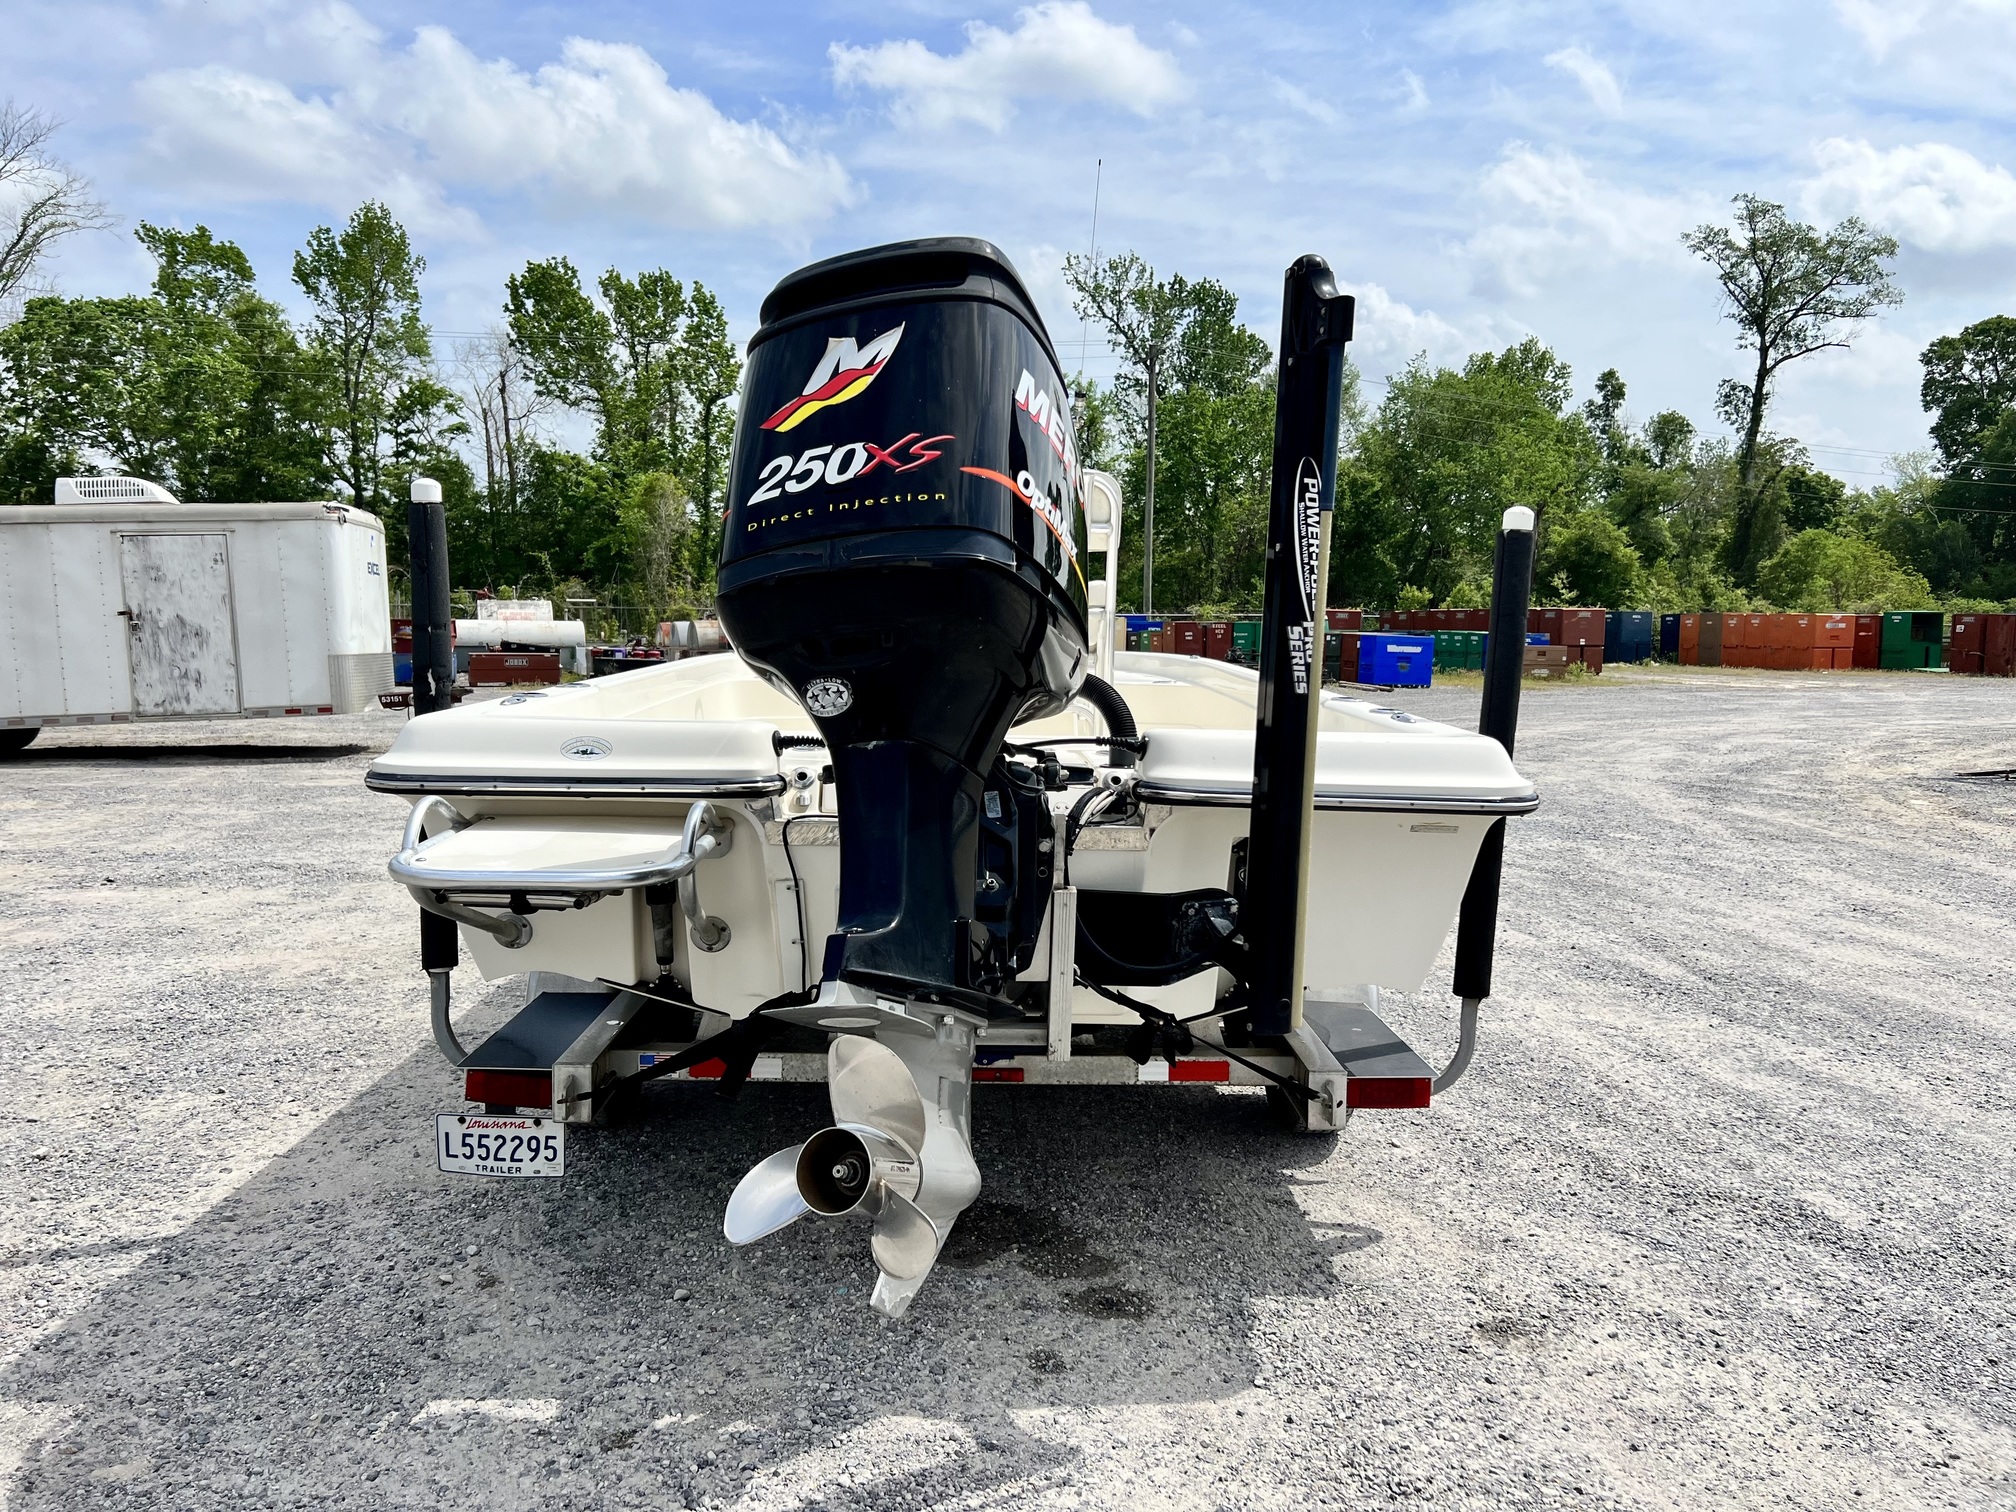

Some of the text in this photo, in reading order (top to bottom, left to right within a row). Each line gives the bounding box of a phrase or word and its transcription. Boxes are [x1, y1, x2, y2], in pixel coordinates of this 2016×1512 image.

[747, 492, 946, 532] Direct Injection
[1297, 502, 1307, 536] SHALLOW
[1300, 536, 1310, 563] WATER
[1302, 477, 1320, 612] POWER-P
[1286, 625, 1308, 694] SERIES
[381, 695, 403, 704] 53151
[465, 1117, 533, 1130] Louisiana
[444, 1131, 558, 1163] L552295
[474, 1164, 523, 1174] TRAILER
